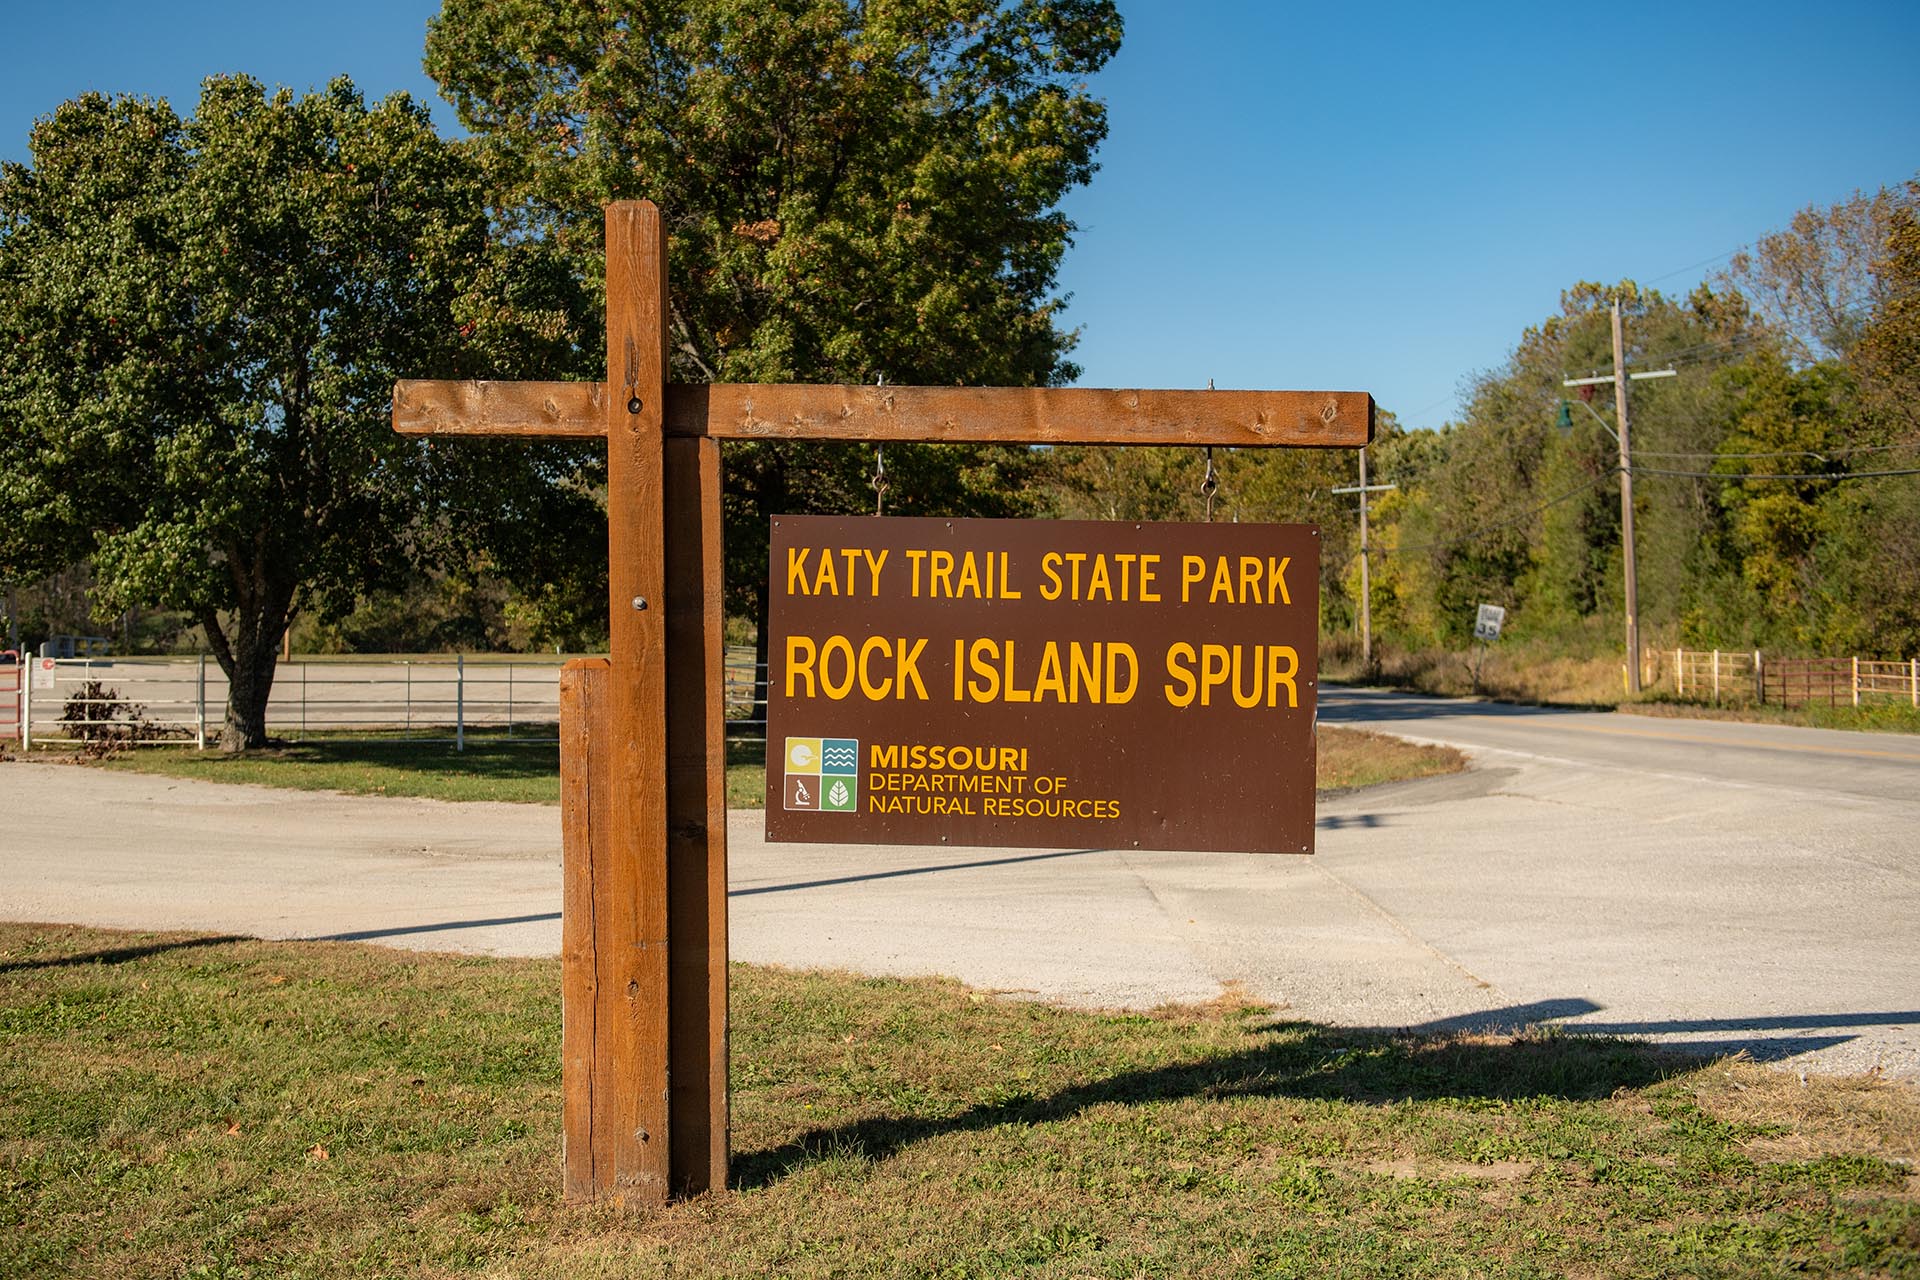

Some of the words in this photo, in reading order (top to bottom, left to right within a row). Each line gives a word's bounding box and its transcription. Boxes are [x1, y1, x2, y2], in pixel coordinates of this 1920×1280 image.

[788, 548, 889, 596] KATY
[906, 550, 1021, 599] TRAIL
[1040, 552, 1161, 602] STATE
[1182, 556, 1291, 604] PARK
[1477, 623, 1497, 636] 35
[786, 635, 929, 701] ROCK
[954, 638, 1138, 704] ISLAND
[1165, 642, 1298, 708] SPUR
[871, 745, 1027, 771] MISSOURI
[870, 773, 1027, 793] DEPARTMENT
[1034, 777, 1067, 794] OF
[870, 795, 976, 815] NATURAL
[984, 798, 1120, 818] RESOURCES
